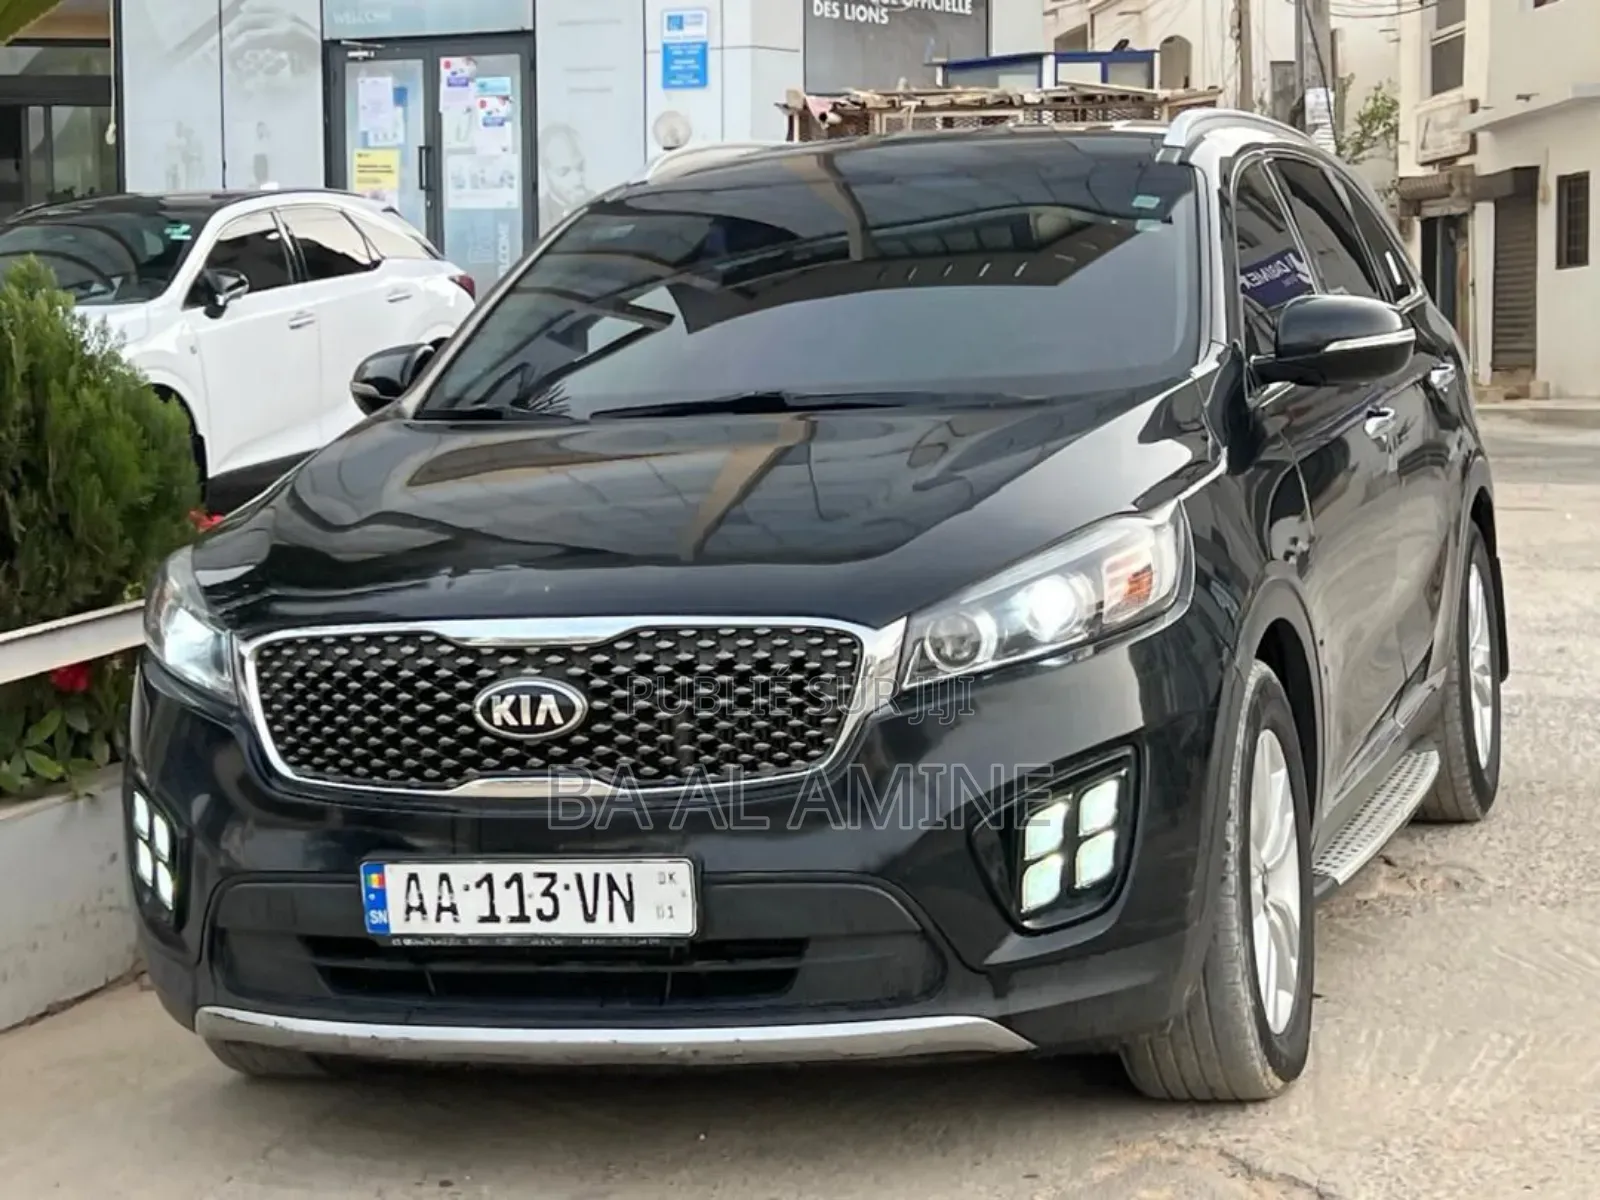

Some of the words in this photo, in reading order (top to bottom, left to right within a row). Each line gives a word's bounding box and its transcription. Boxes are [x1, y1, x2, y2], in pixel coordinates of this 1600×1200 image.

[812, 1, 841, 19] DES
[843, 3, 889, 25] LIONS
[491, 694, 564, 726] KIA
[369, 909, 389, 925] SN
